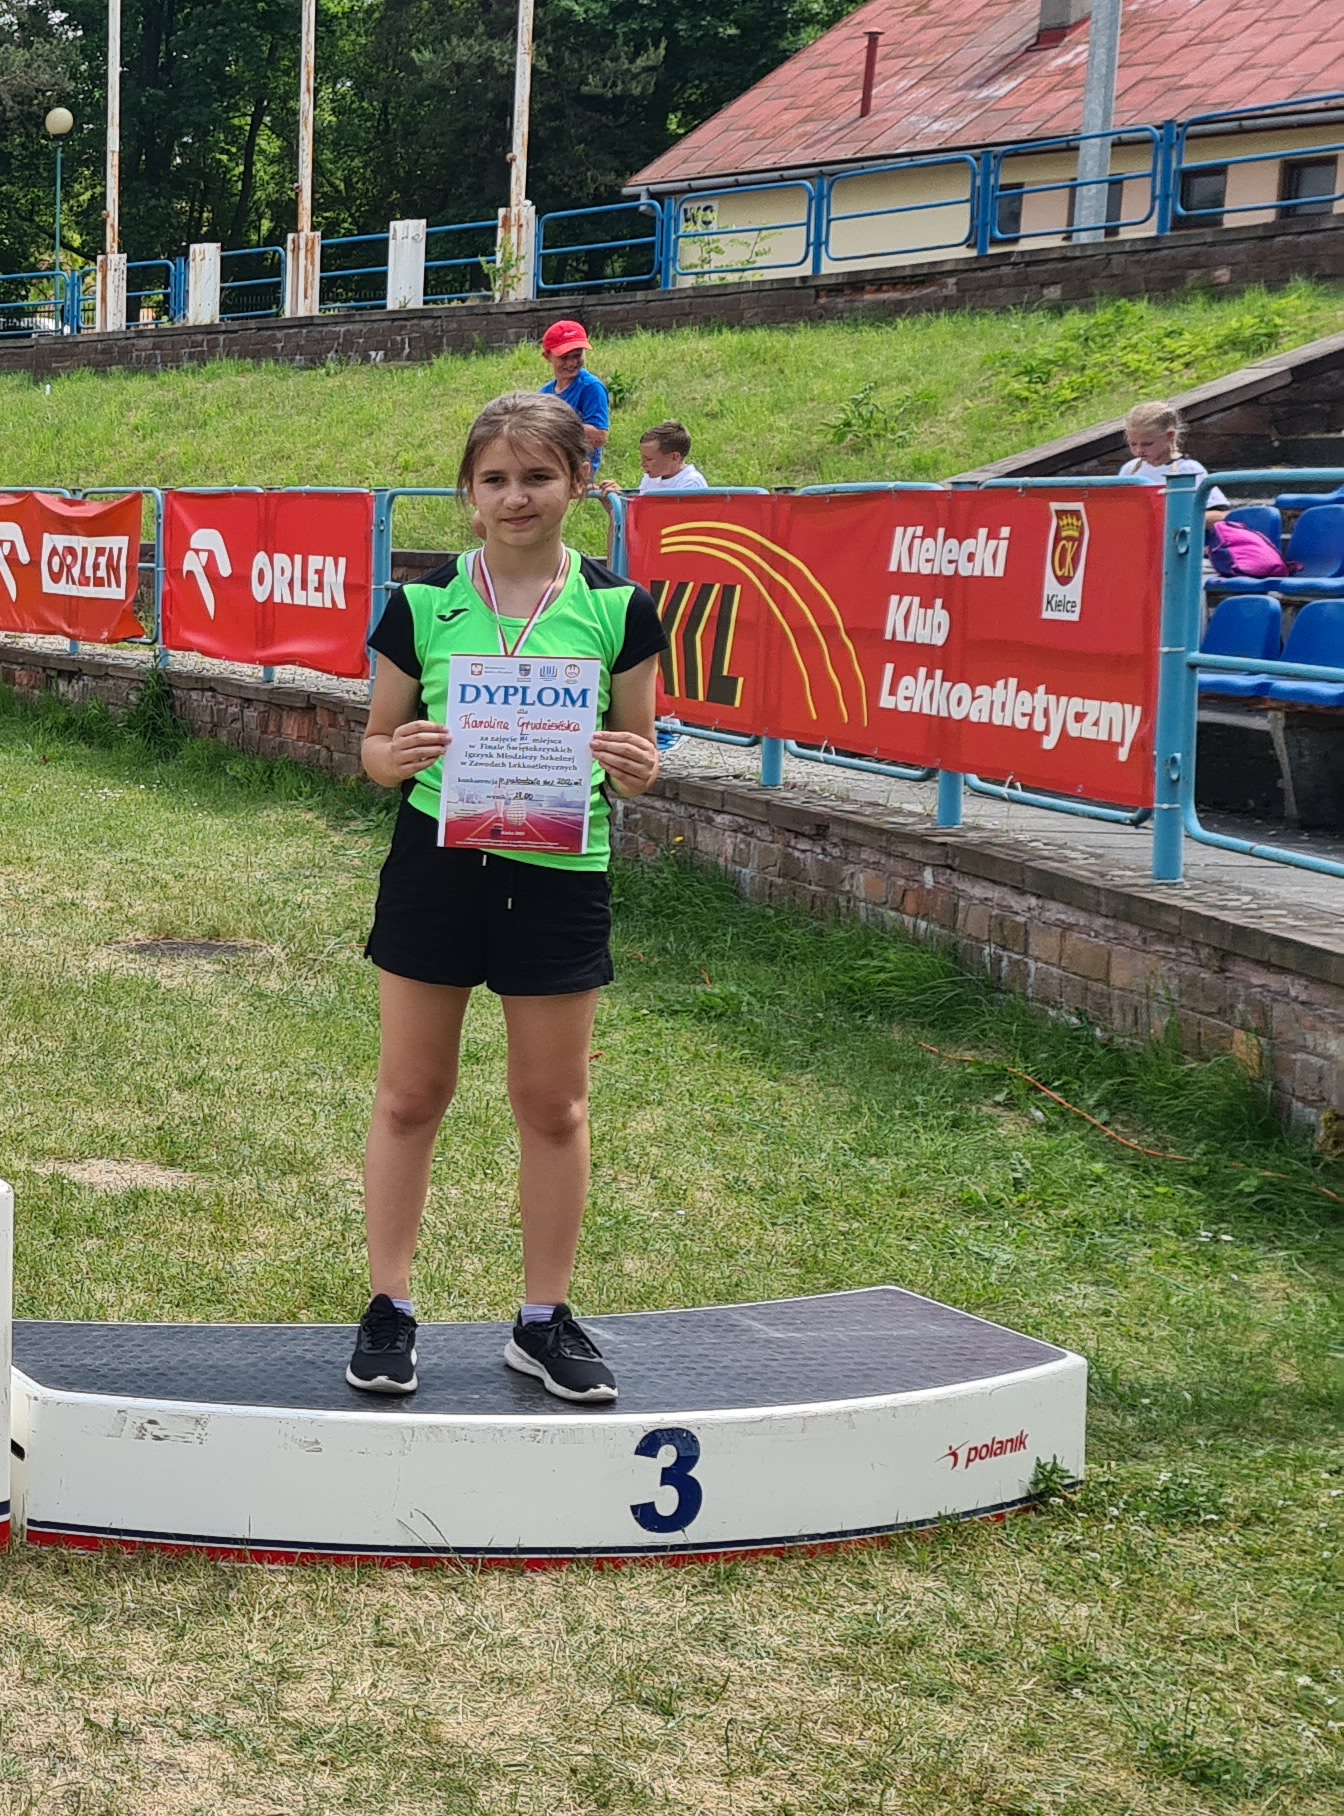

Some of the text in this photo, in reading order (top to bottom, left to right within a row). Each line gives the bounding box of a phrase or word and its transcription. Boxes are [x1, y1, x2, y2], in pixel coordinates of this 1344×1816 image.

[47, 543, 123, 589] ORLEN
[888, 526, 1011, 577] Kielecki
[1054, 539, 1079, 577] CK
[251, 551, 348, 610] ORLEN
[1045, 594, 1077, 613] Kielce
[884, 595, 951, 647] Klub
[458, 683, 591, 708] DYPLOM
[879, 663, 1142, 762] Lekkoatletyczny
[459, 713, 510, 730] Karolina
[965, 1429, 1029, 1470] polanik
[630, 1427, 703, 1533] 3
